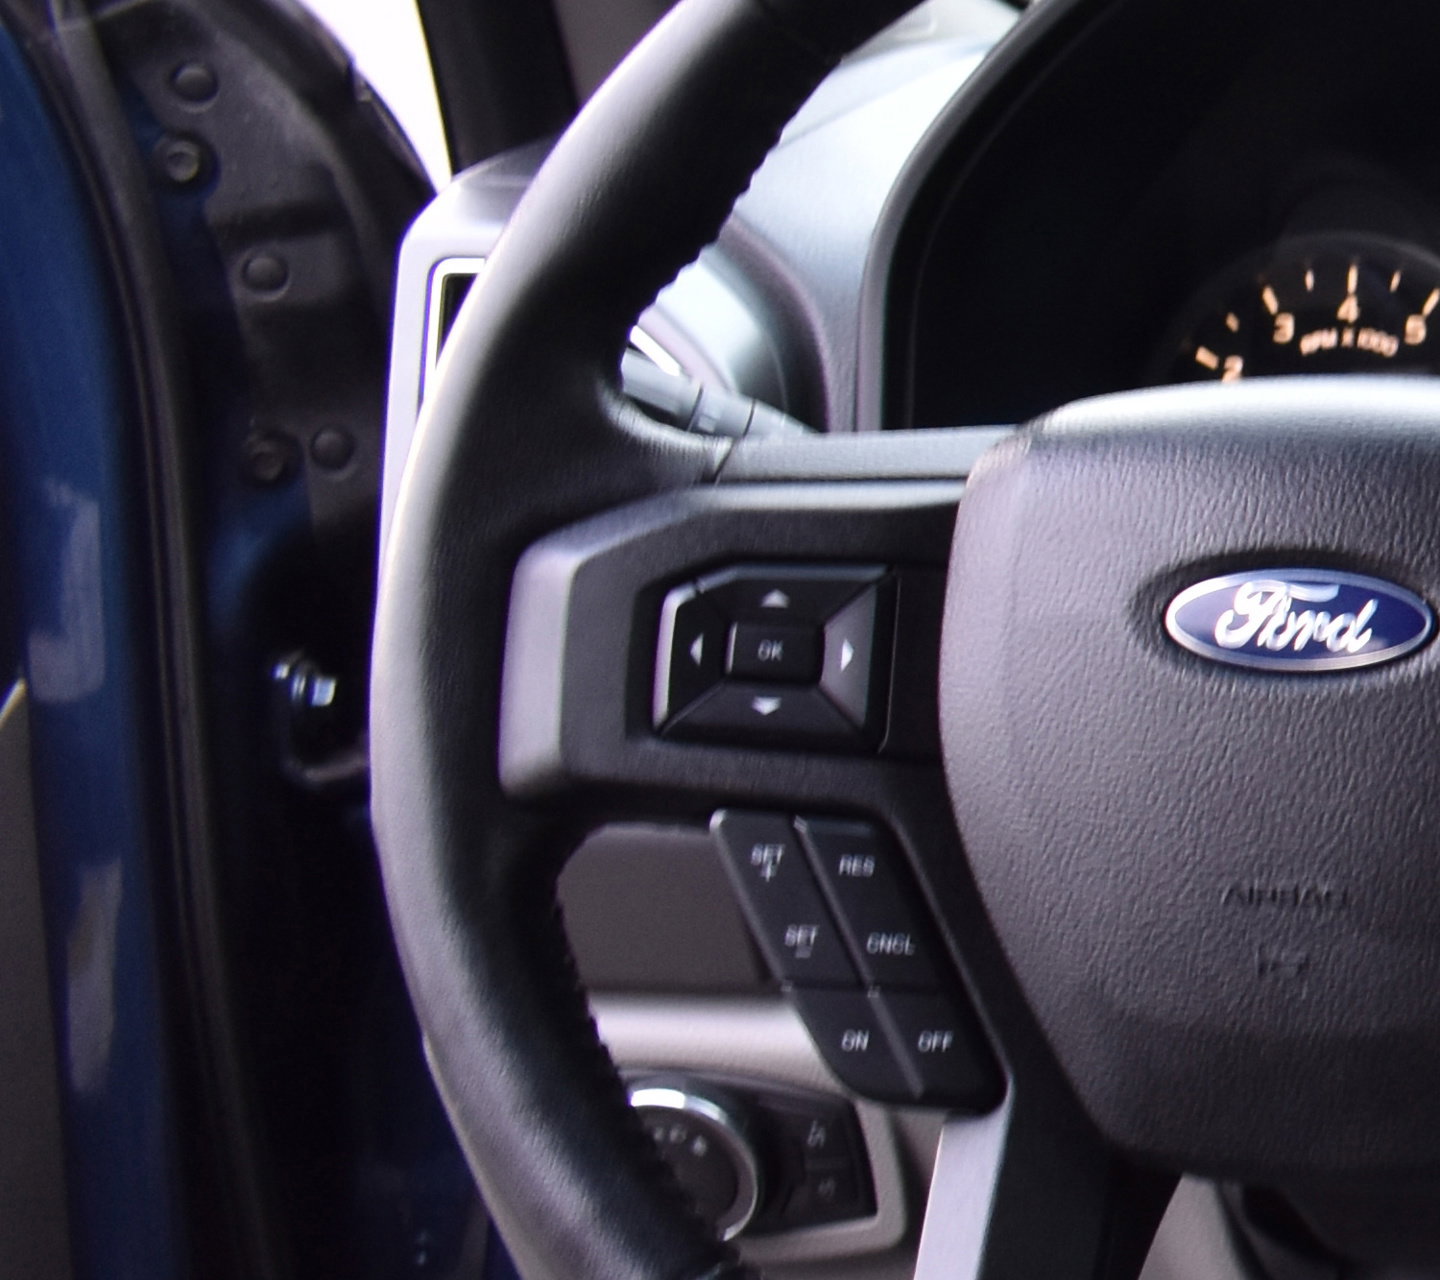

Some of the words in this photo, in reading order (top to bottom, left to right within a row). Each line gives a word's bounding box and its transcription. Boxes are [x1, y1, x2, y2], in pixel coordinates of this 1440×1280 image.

[1337, 295, 1360, 323] 4
[1273, 312, 1295, 343] 3
[1213, 580, 1376, 655] Ford
[756, 641, 783, 661] OK
[751, 844, 785, 866] SET
[837, 855, 877, 877] RES
[784, 925, 819, 947] SET
[841, 1029, 871, 1053] ON
[917, 1030, 954, 1054] OFF
